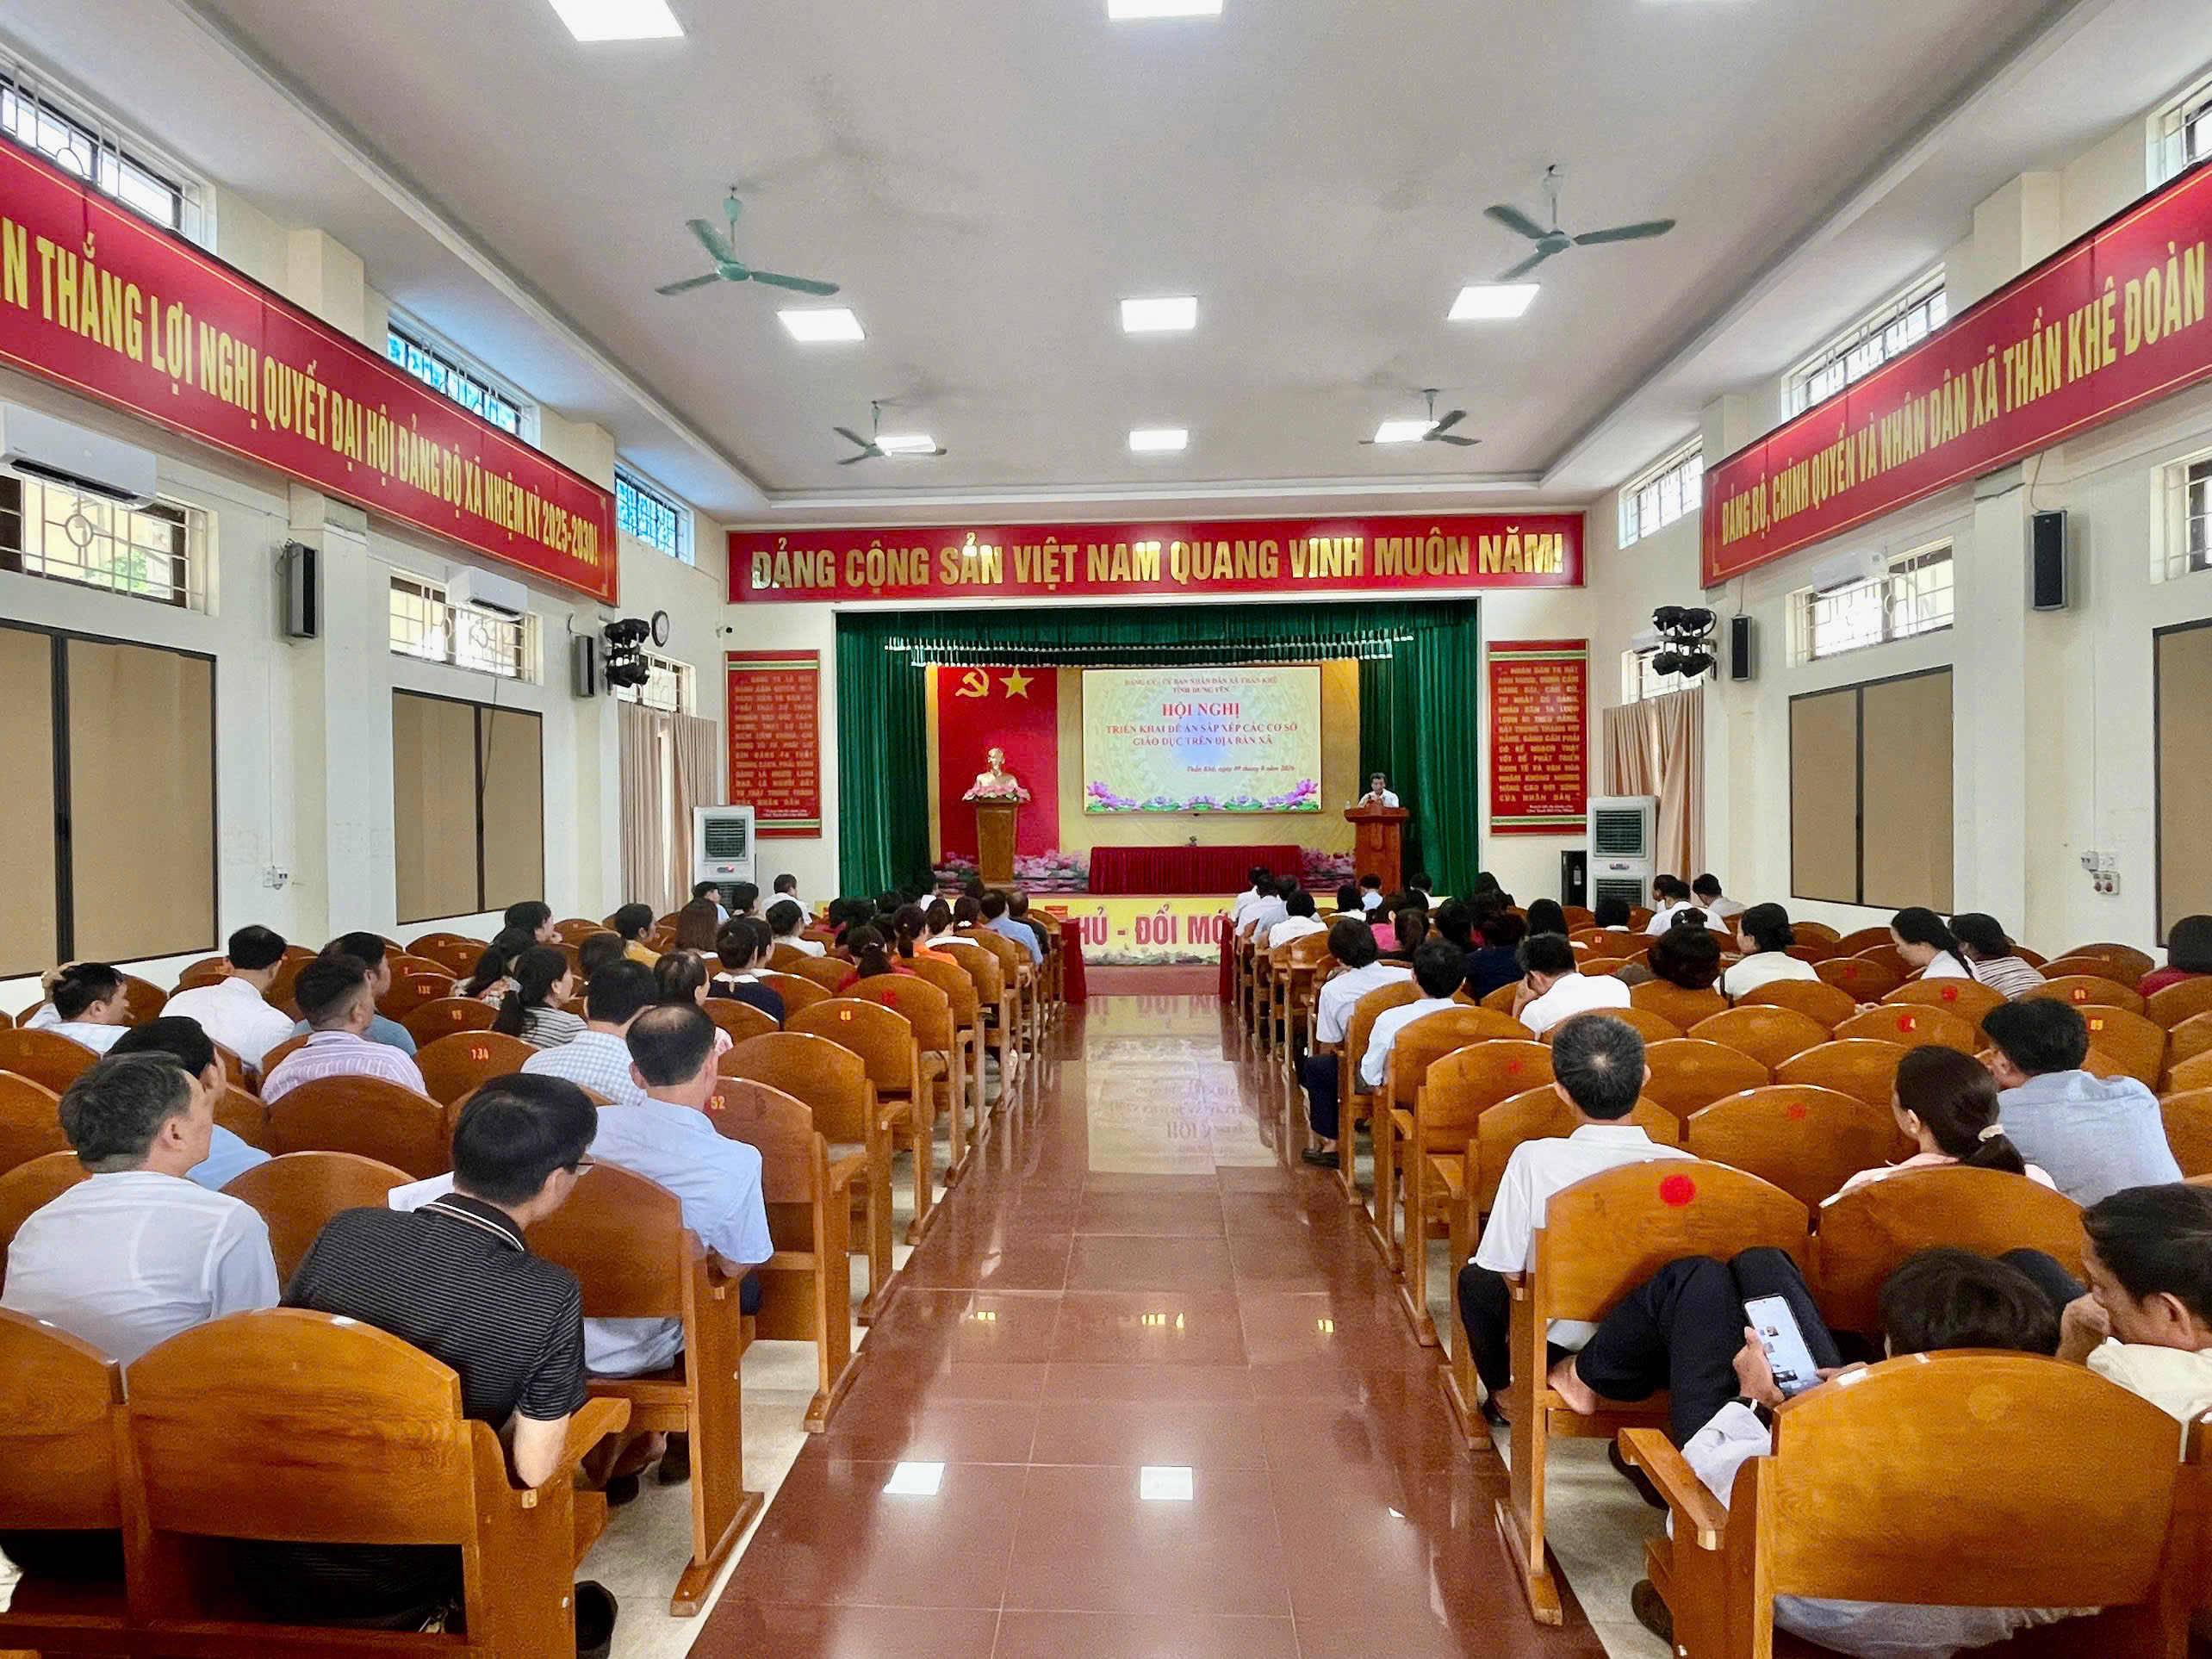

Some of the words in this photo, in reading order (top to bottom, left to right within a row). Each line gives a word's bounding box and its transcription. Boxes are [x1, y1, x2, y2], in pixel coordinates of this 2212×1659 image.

[36, 231, 143, 363] THẮNG
[151, 295, 193, 396] LỢI
[199, 320, 258, 431] NGHỊ
[264, 359, 327, 446] QUYẾT
[331, 390, 363, 472] ĐẠI
[366, 403, 395, 487] HỘI
[399, 413, 440, 498] ĐẢNG
[443, 444, 463, 519] BỘ
[464, 455, 482, 517] XÃ
[485, 470, 525, 541] NHIỆM
[526, 484, 541, 541] KỲ
[542, 500, 599, 567] 2025-2030!
[1723, 482, 1750, 546] ĐẢNG
[1752, 472, 1771, 540] BỘ,
[1773, 457, 1810, 523] CHÍNH
[1811, 421, 1855, 511] QUYỀN
[1858, 412, 1878, 482] VÀ
[1880, 391, 1926, 473] NHÂN
[1929, 368, 1967, 450] DÂN
[1972, 344, 1999, 430] XÃ
[2003, 305, 2062, 413] THẦN
[2067, 275, 2116, 384] KHÊ
[751, 536, 836, 590] ĐẢNG
[844, 538, 930, 593] CỘNG
[939, 531, 1003, 586] SẢN
[1012, 536, 1078, 591] VIỆT
[1086, 540, 1162, 583] NAM
[1170, 539, 1279, 586] QUANG
[1288, 537, 1365, 580] VINH
[1373, 526, 1469, 577] MUÔN
[1477, 525, 1564, 575] NĂM!
[1162, 701, 1192, 719] HỘI
[1197, 702, 1240, 719] NGHỊ
[1106, 724, 1137, 734] TRIỂN
[1139, 724, 1165, 734] KHAI
[1243, 721, 1264, 732] CÁC
[1133, 735, 1159, 745] GIÁO
[1161, 736, 1183, 748] DỤC
[1185, 735, 1213, 745] TRÊN
[1079, 905, 1108, 946] HỦ
[1134, 904, 1178, 945] ĐỔI
[470, 1047, 490, 1061] 134
[710, 1095, 726, 1110] 52
